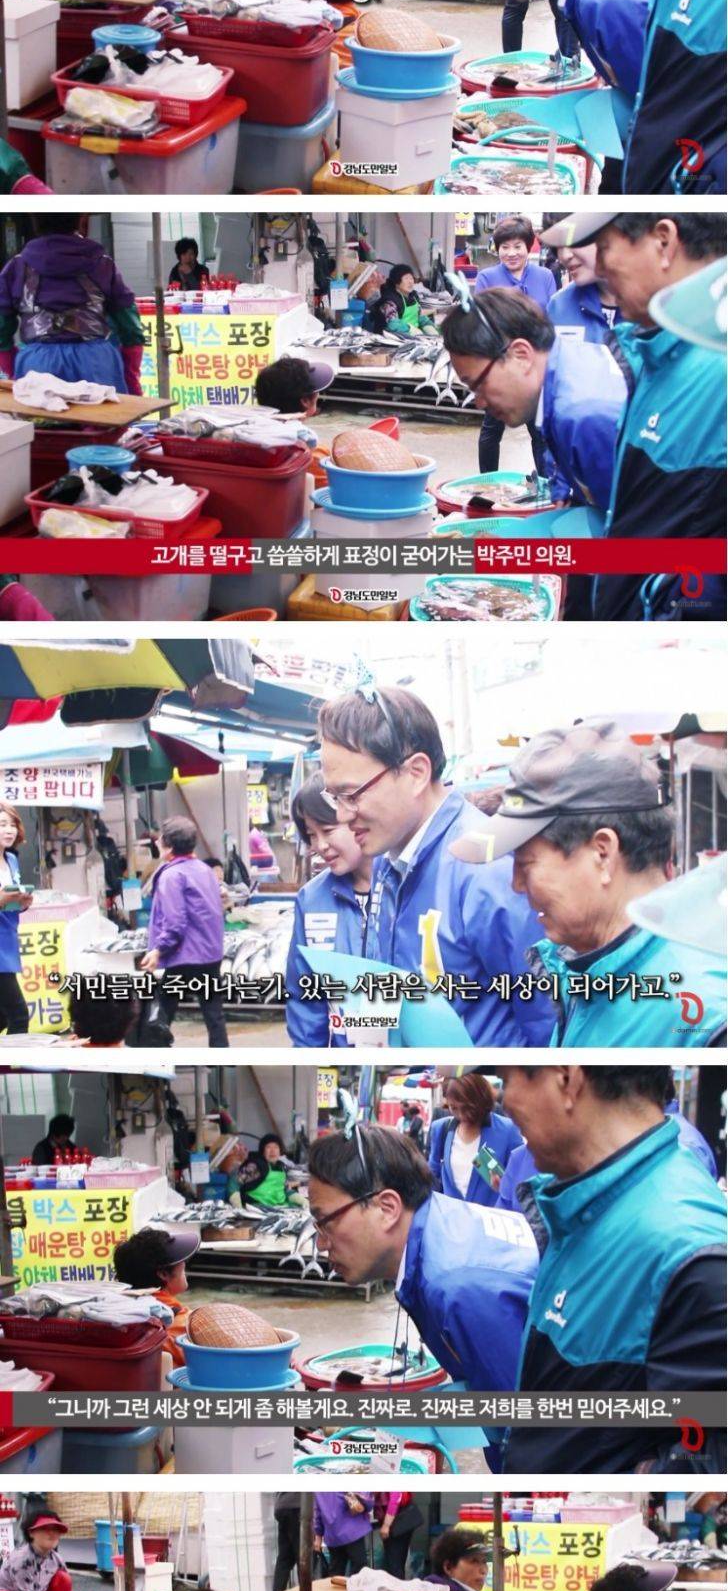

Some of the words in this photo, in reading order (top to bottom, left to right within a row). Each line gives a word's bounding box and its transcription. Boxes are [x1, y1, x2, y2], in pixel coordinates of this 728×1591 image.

[227, 322, 272, 348] 포장
[176, 354, 230, 381] 매운탕
[206, 386, 258, 406] 택배가
[44, 780, 95, 799] 팝니다
[32, 1197, 77, 1224] 박스
[83, 1196, 130, 1224] 포장
[28, 1230, 87, 1259] 매운탕
[557, 1532, 604, 1558] 포장
[503, 1563, 559, 1591] 매운탕
